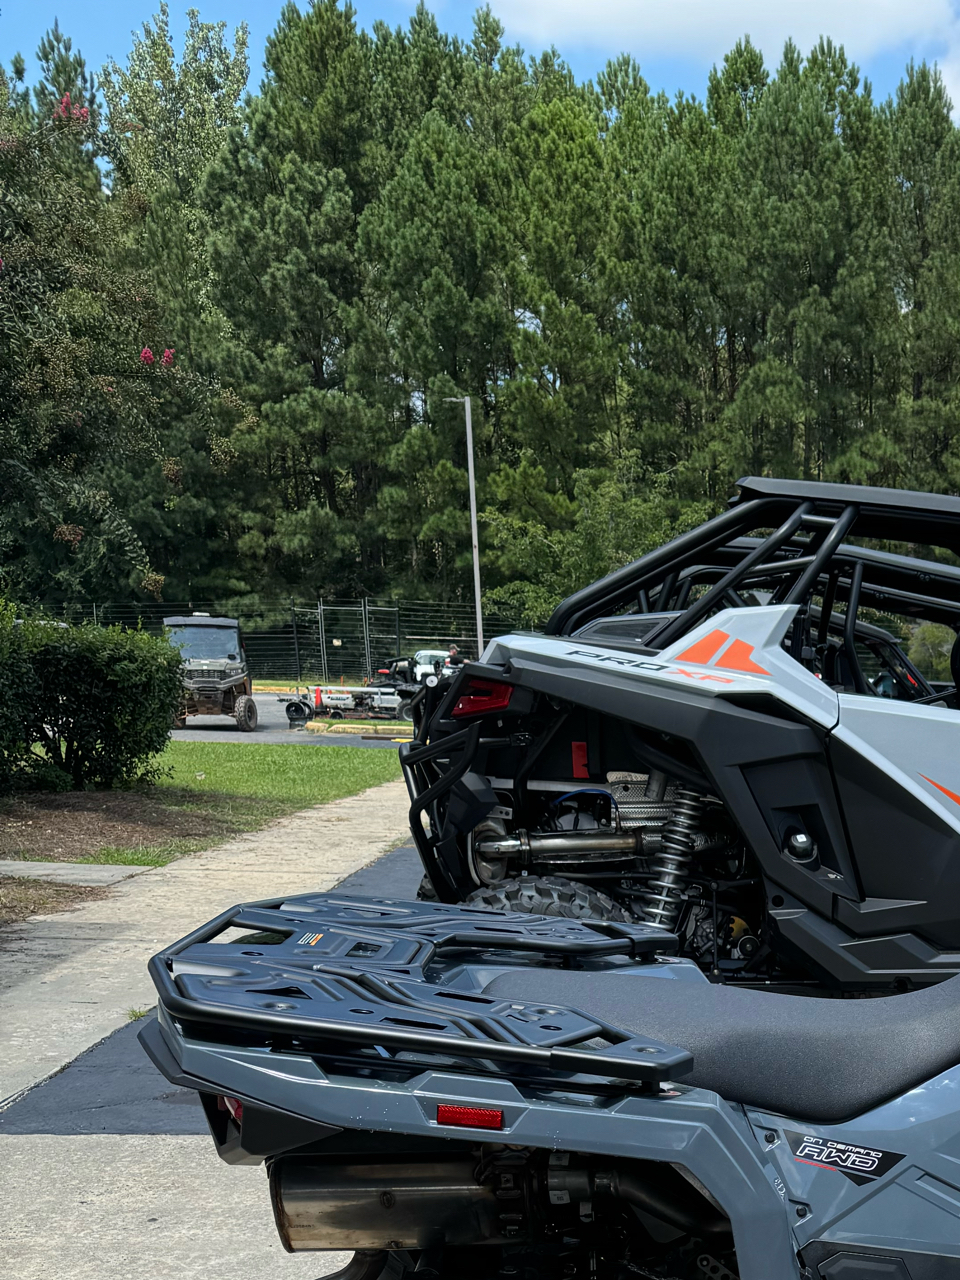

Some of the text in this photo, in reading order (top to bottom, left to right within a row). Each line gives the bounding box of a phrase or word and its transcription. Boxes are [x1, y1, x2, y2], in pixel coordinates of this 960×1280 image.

[565, 650, 735, 684] PRO XP
[796, 1143, 879, 1171] AWD
[803, 1136, 883, 1158] ON DEMAND
